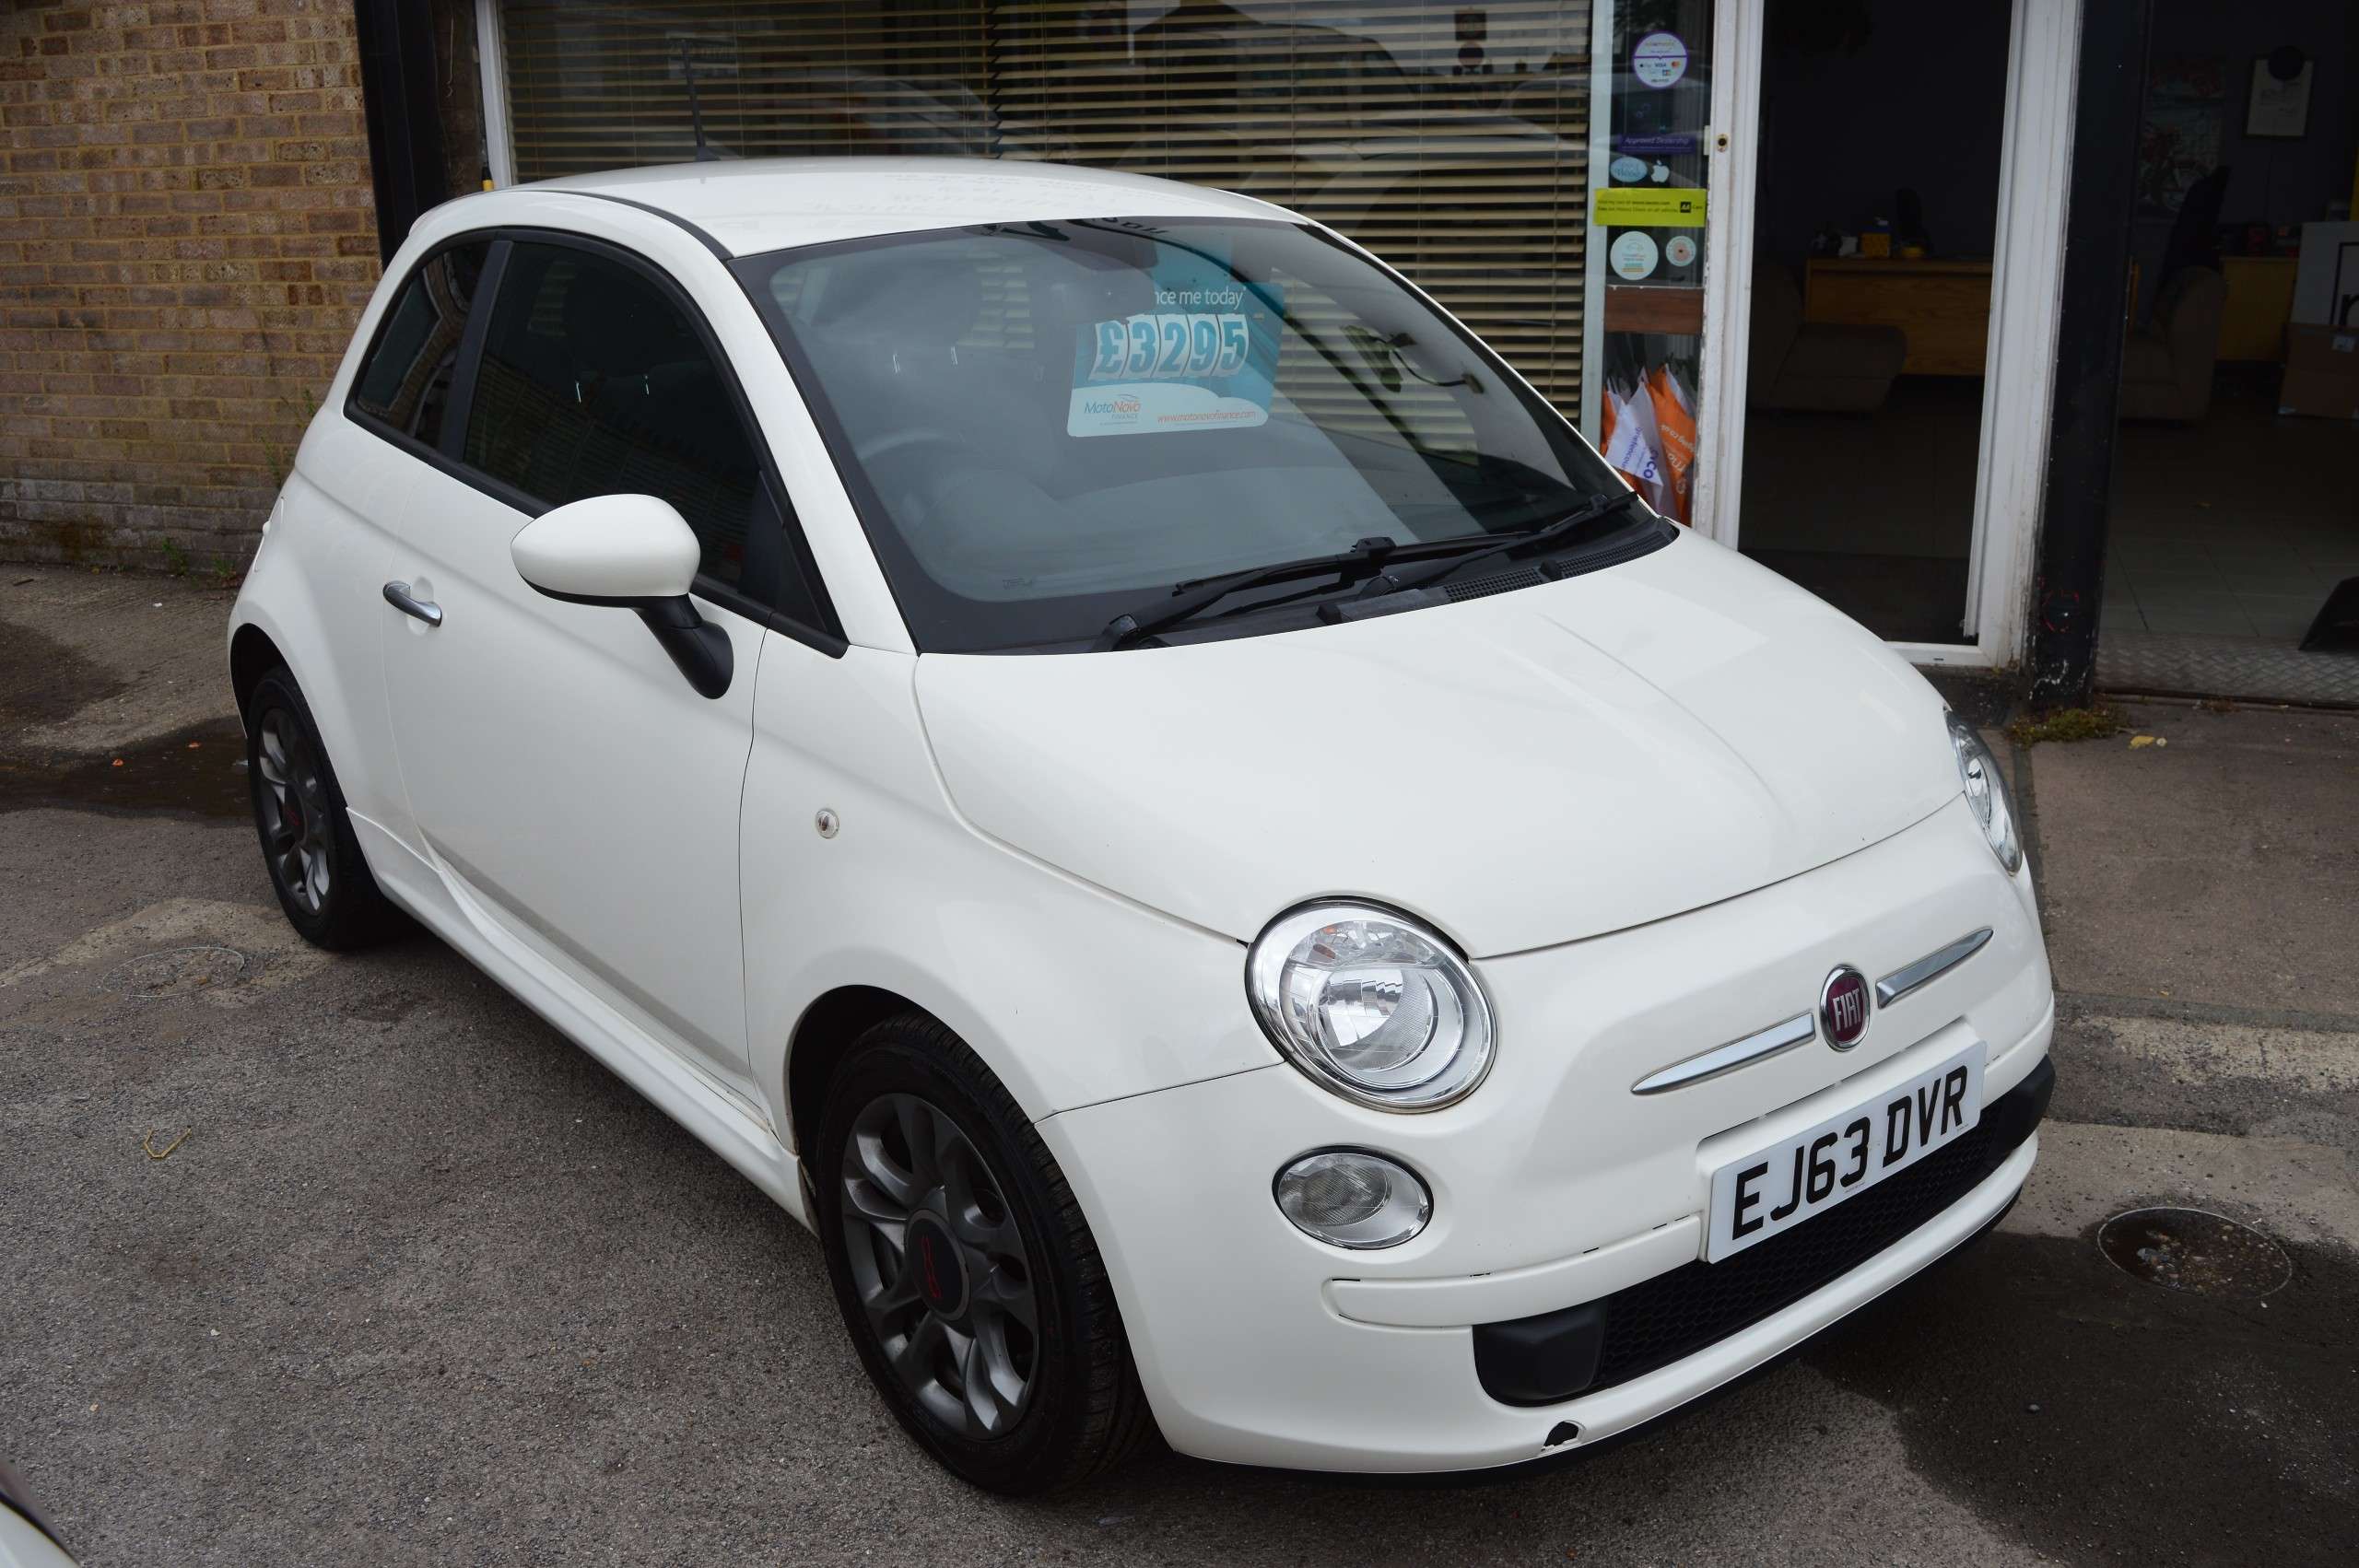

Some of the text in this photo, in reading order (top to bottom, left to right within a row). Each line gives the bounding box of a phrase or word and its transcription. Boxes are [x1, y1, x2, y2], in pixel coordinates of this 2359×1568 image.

[1180, 291, 1202, 305] me
[1095, 320, 1247, 373] £3295
[1084, 401, 1141, 414] MotoNovo
[1832, 988, 1861, 1032] FIAT
[1732, 1065, 1967, 1241] EJ63 DVR
